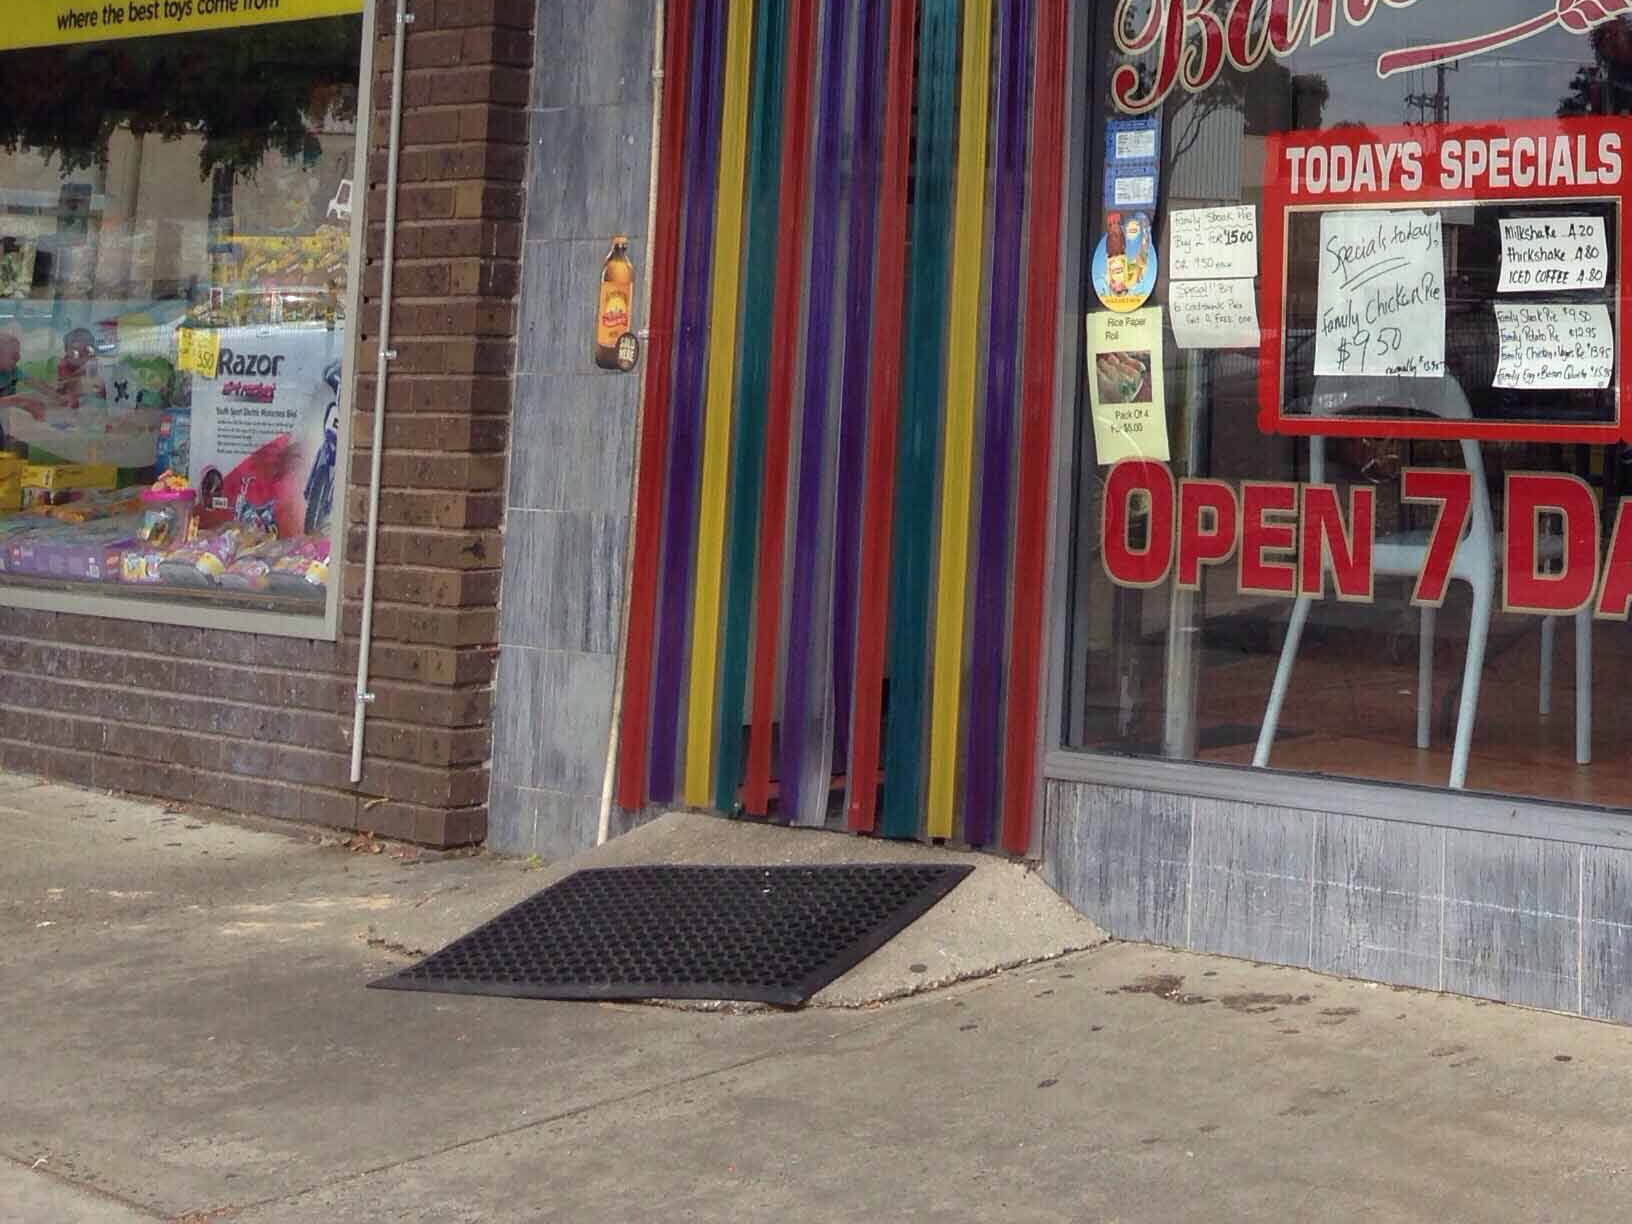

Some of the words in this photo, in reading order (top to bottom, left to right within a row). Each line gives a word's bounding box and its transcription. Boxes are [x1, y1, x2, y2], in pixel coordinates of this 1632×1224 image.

[57, 9, 98, 30] where
[102, 4, 124, 25] the
[128, 1, 160, 22] best
[1286, 144, 1424, 194] TODAY'S
[1440, 133, 1623, 189] SPECIALS
[1504, 225, 1556, 241] Milkshake
[1326, 224, 1387, 281] Specials
[1422, 272, 1440, 302] Pie
[1509, 270, 1531, 284] ICED
[1535, 269, 1569, 284] COFFEE
[1107, 317, 1124, 327] Rice
[1125, 317, 1146, 328] Paper
[218, 348, 285, 377] Razor
[1115, 410, 1132, 420] Pack
[1100, 457, 1376, 605] OPEN
[1400, 469, 1474, 609] 7
